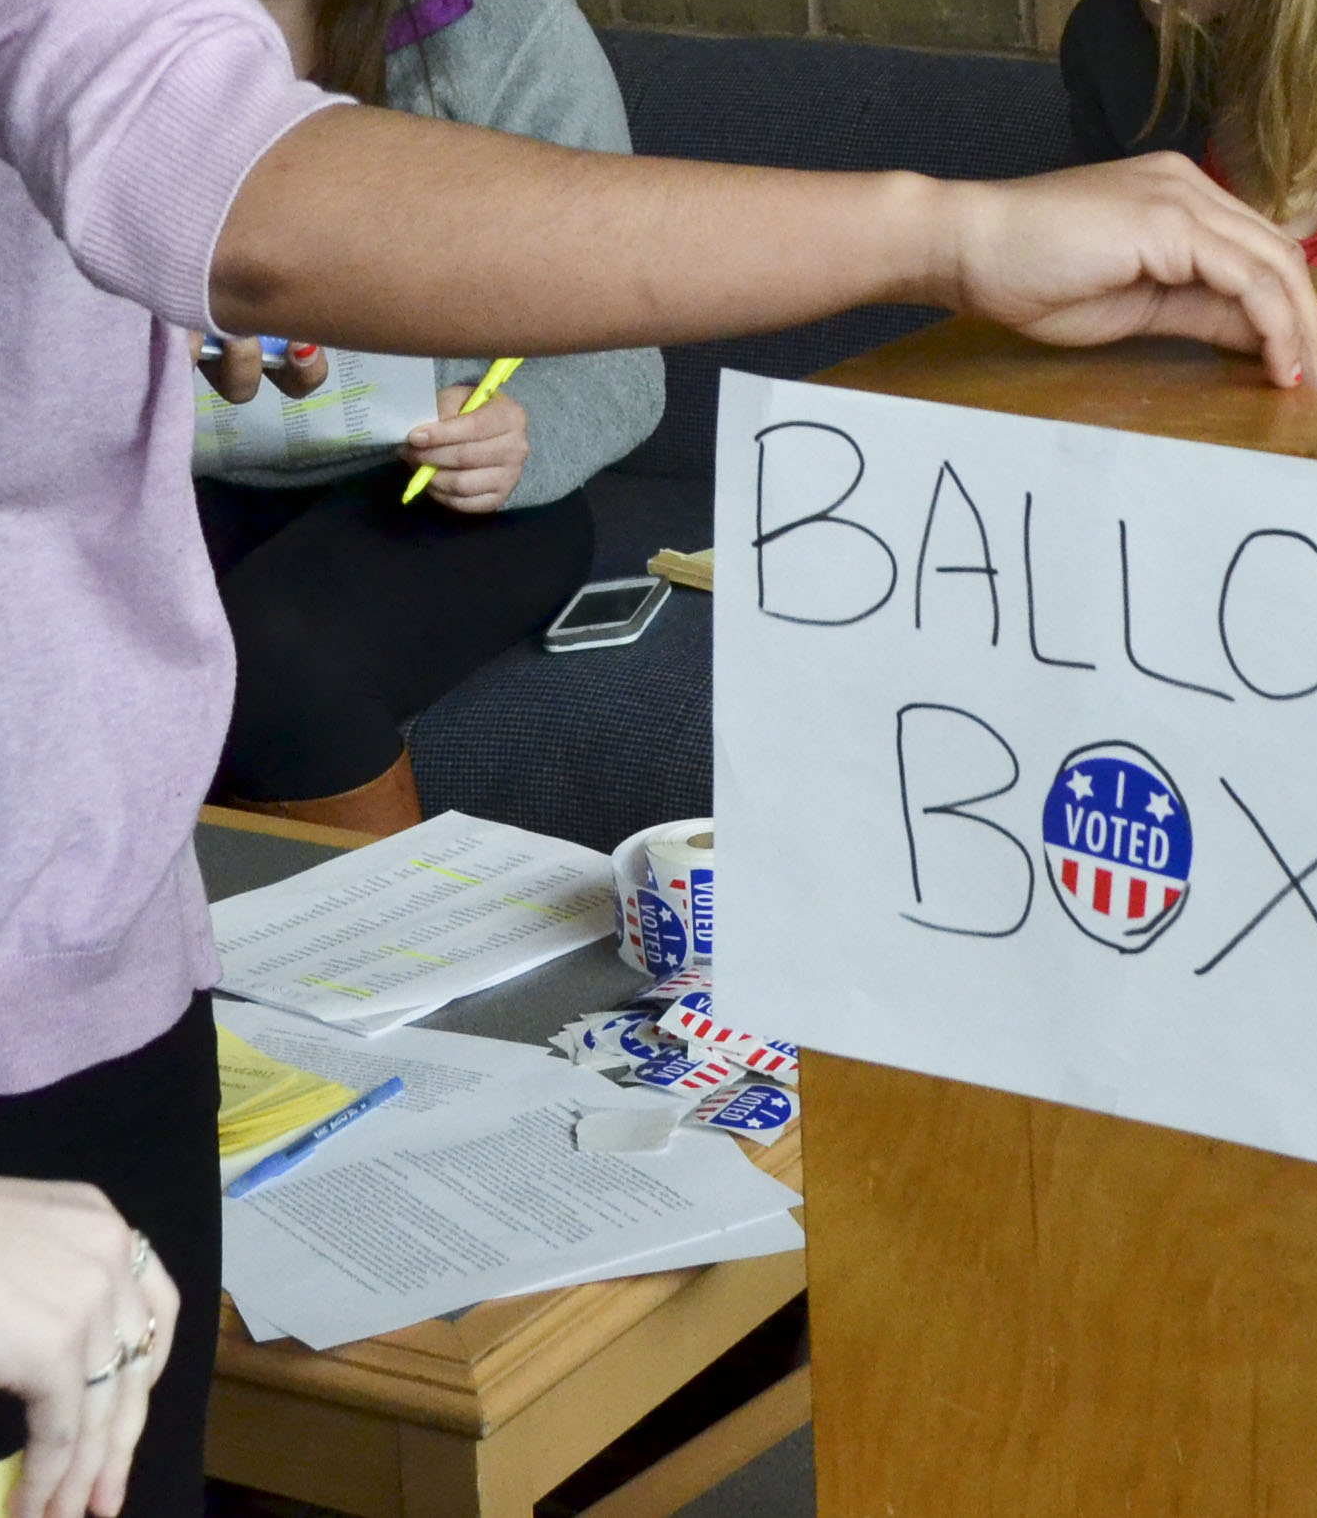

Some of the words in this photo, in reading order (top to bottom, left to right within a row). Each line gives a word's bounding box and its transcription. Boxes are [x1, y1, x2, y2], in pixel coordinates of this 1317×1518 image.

[1115, 771, 1126, 810] I
[1065, 803, 1170, 870] VOTED
[640, 902, 662, 965] VOTED
[653, 1056, 697, 1080] VOT
[720, 1091, 771, 1122] VOTED
